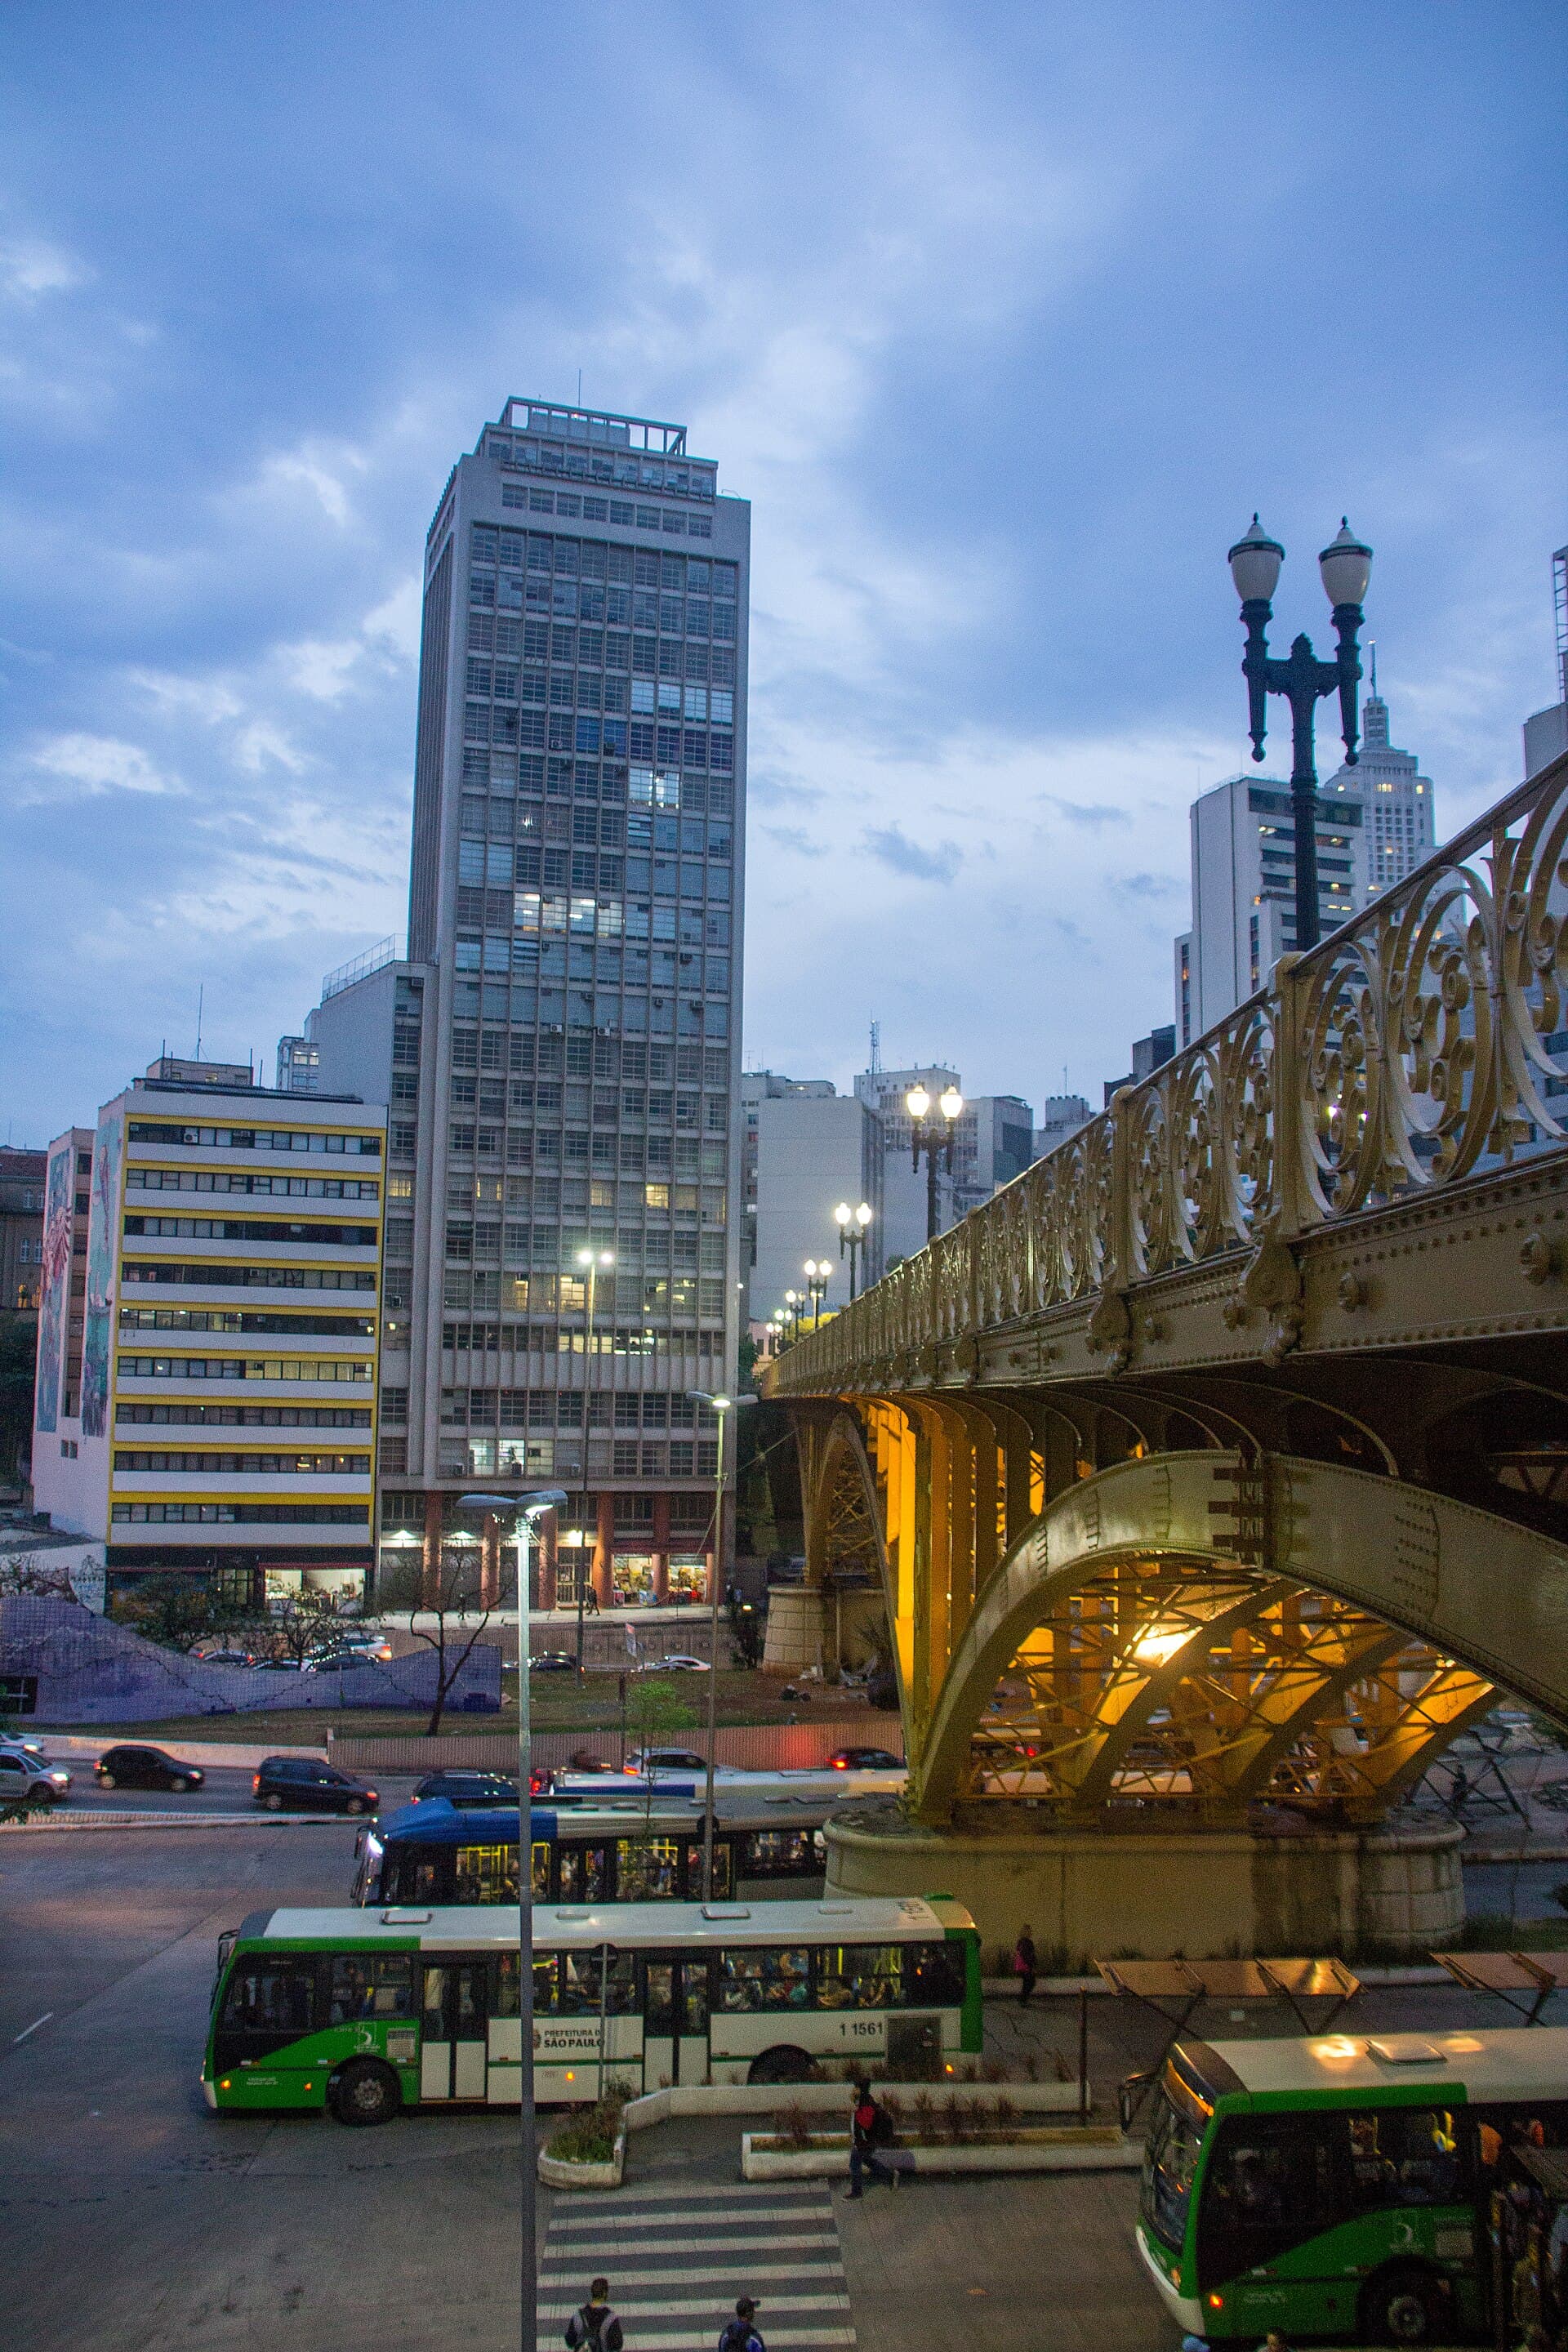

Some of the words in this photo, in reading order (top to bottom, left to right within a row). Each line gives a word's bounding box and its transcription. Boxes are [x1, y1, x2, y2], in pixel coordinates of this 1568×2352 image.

[840, 2024, 845, 2036] 1
[852, 2022, 884, 2035] 1561
[544, 2038, 567, 2047] SÃO
